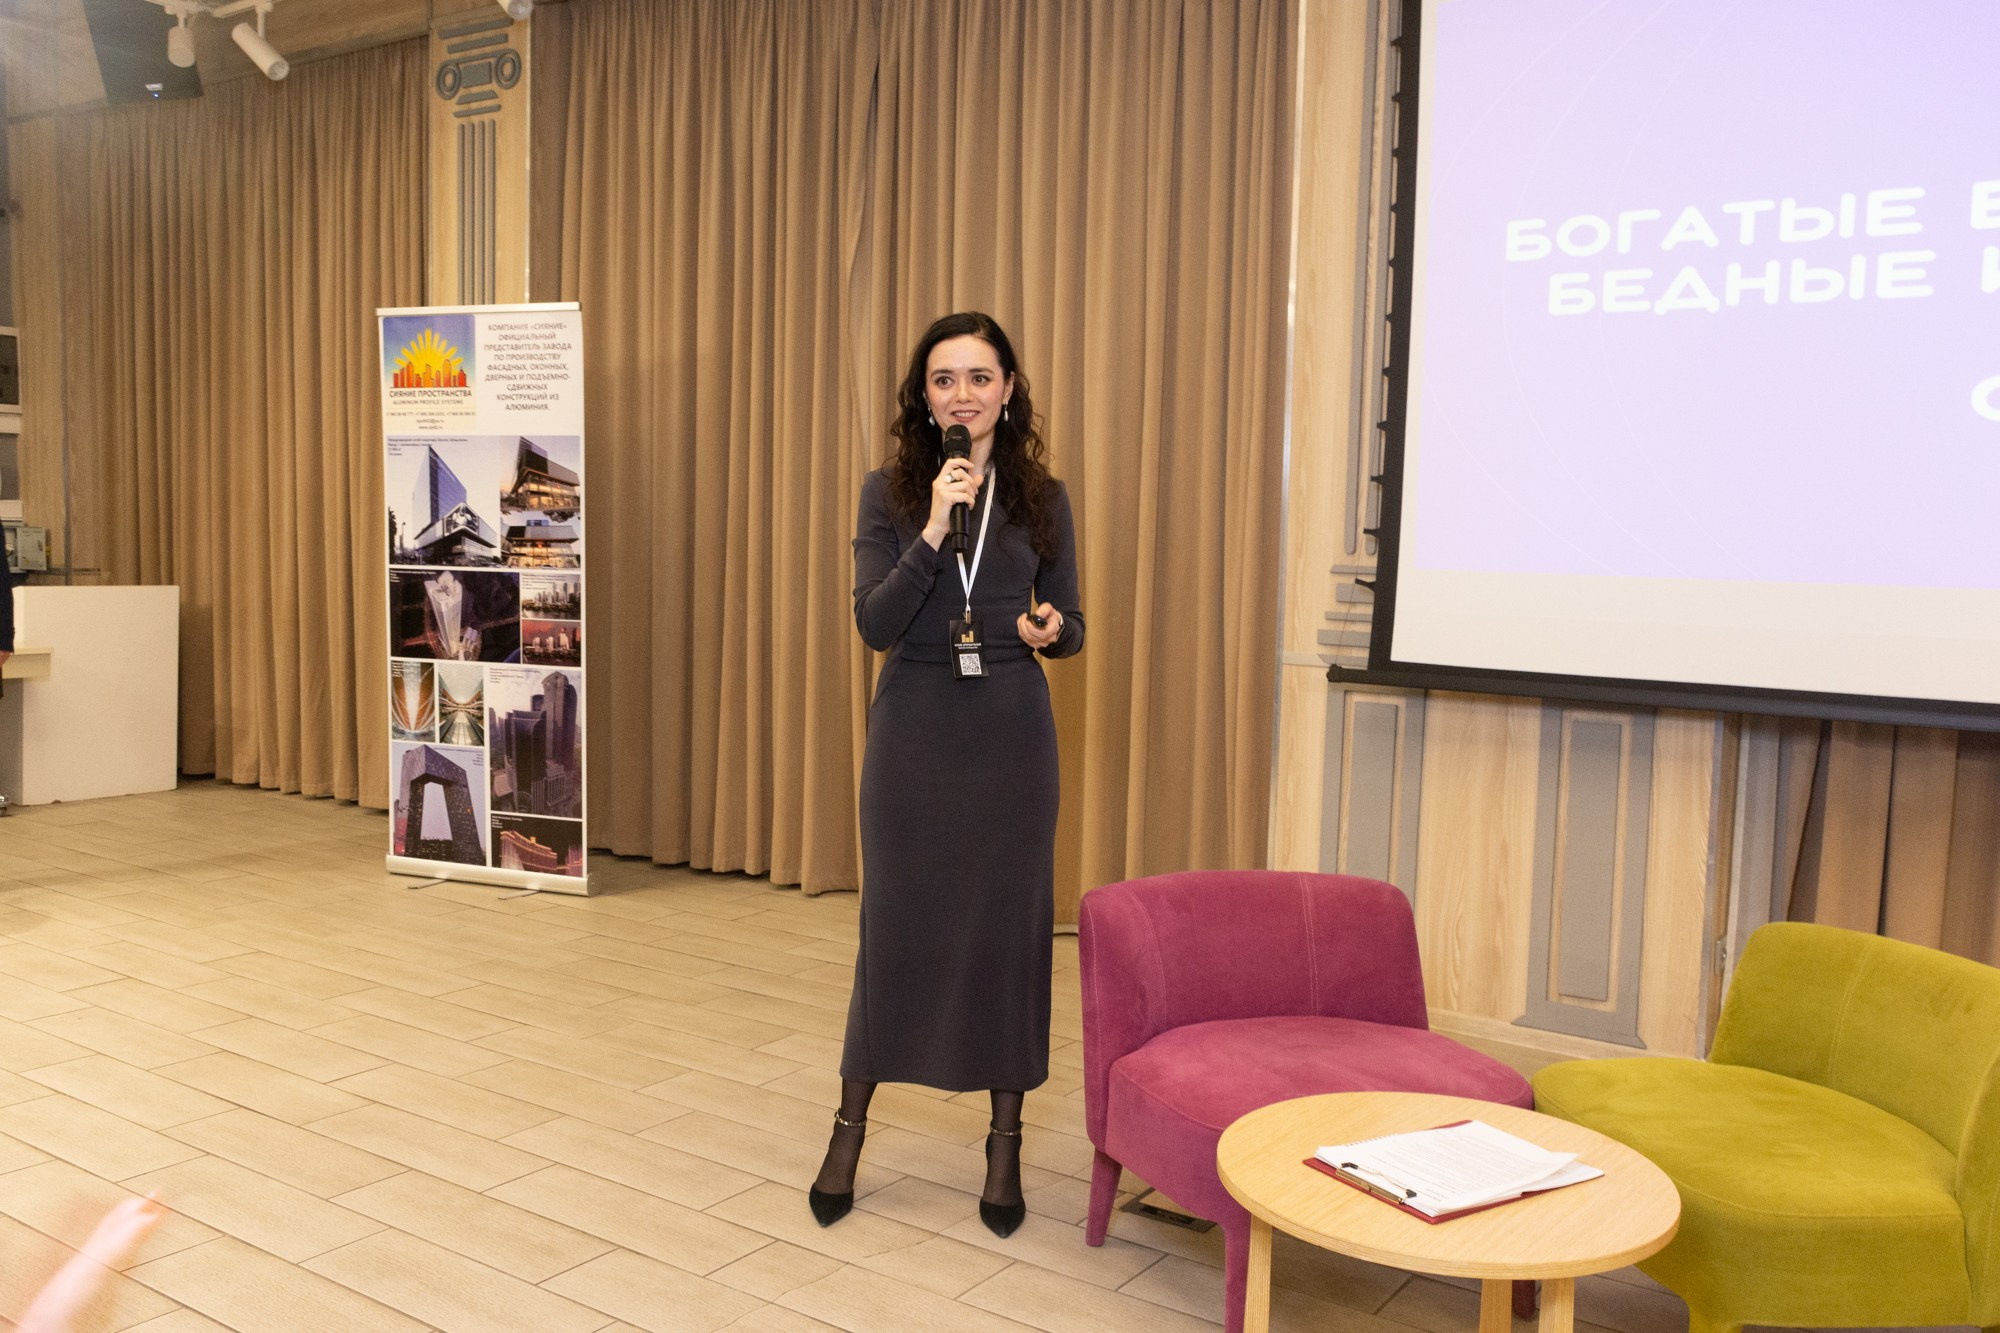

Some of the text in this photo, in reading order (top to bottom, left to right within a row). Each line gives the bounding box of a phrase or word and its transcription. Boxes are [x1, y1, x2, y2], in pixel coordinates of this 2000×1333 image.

[1505, 187, 1926, 262] БОГАТЫЕ
[1548, 250, 1936, 316] БЕДНЫЕ
[488, 323, 528, 331] КОМПАНИЯ
[498, 332, 556, 341] ОФИЦИАЛЬНЫЙ
[484, 343, 572, 351] ПРЕДСТАВИТЕЛЬ ЗАВОДА
[494, 353, 561, 361] ПО ПРОИЗВОДСТВУ
[485, 374, 517, 382] ДВЕРНЫХ
[506, 383, 548, 391] СДВИЖНЫХ
[389, 389, 472, 398] СИЯНИЕ ПРОСТРАНСТВА
[496, 392, 560, 401] КОНСТРУКЦИЙ ИЗ
